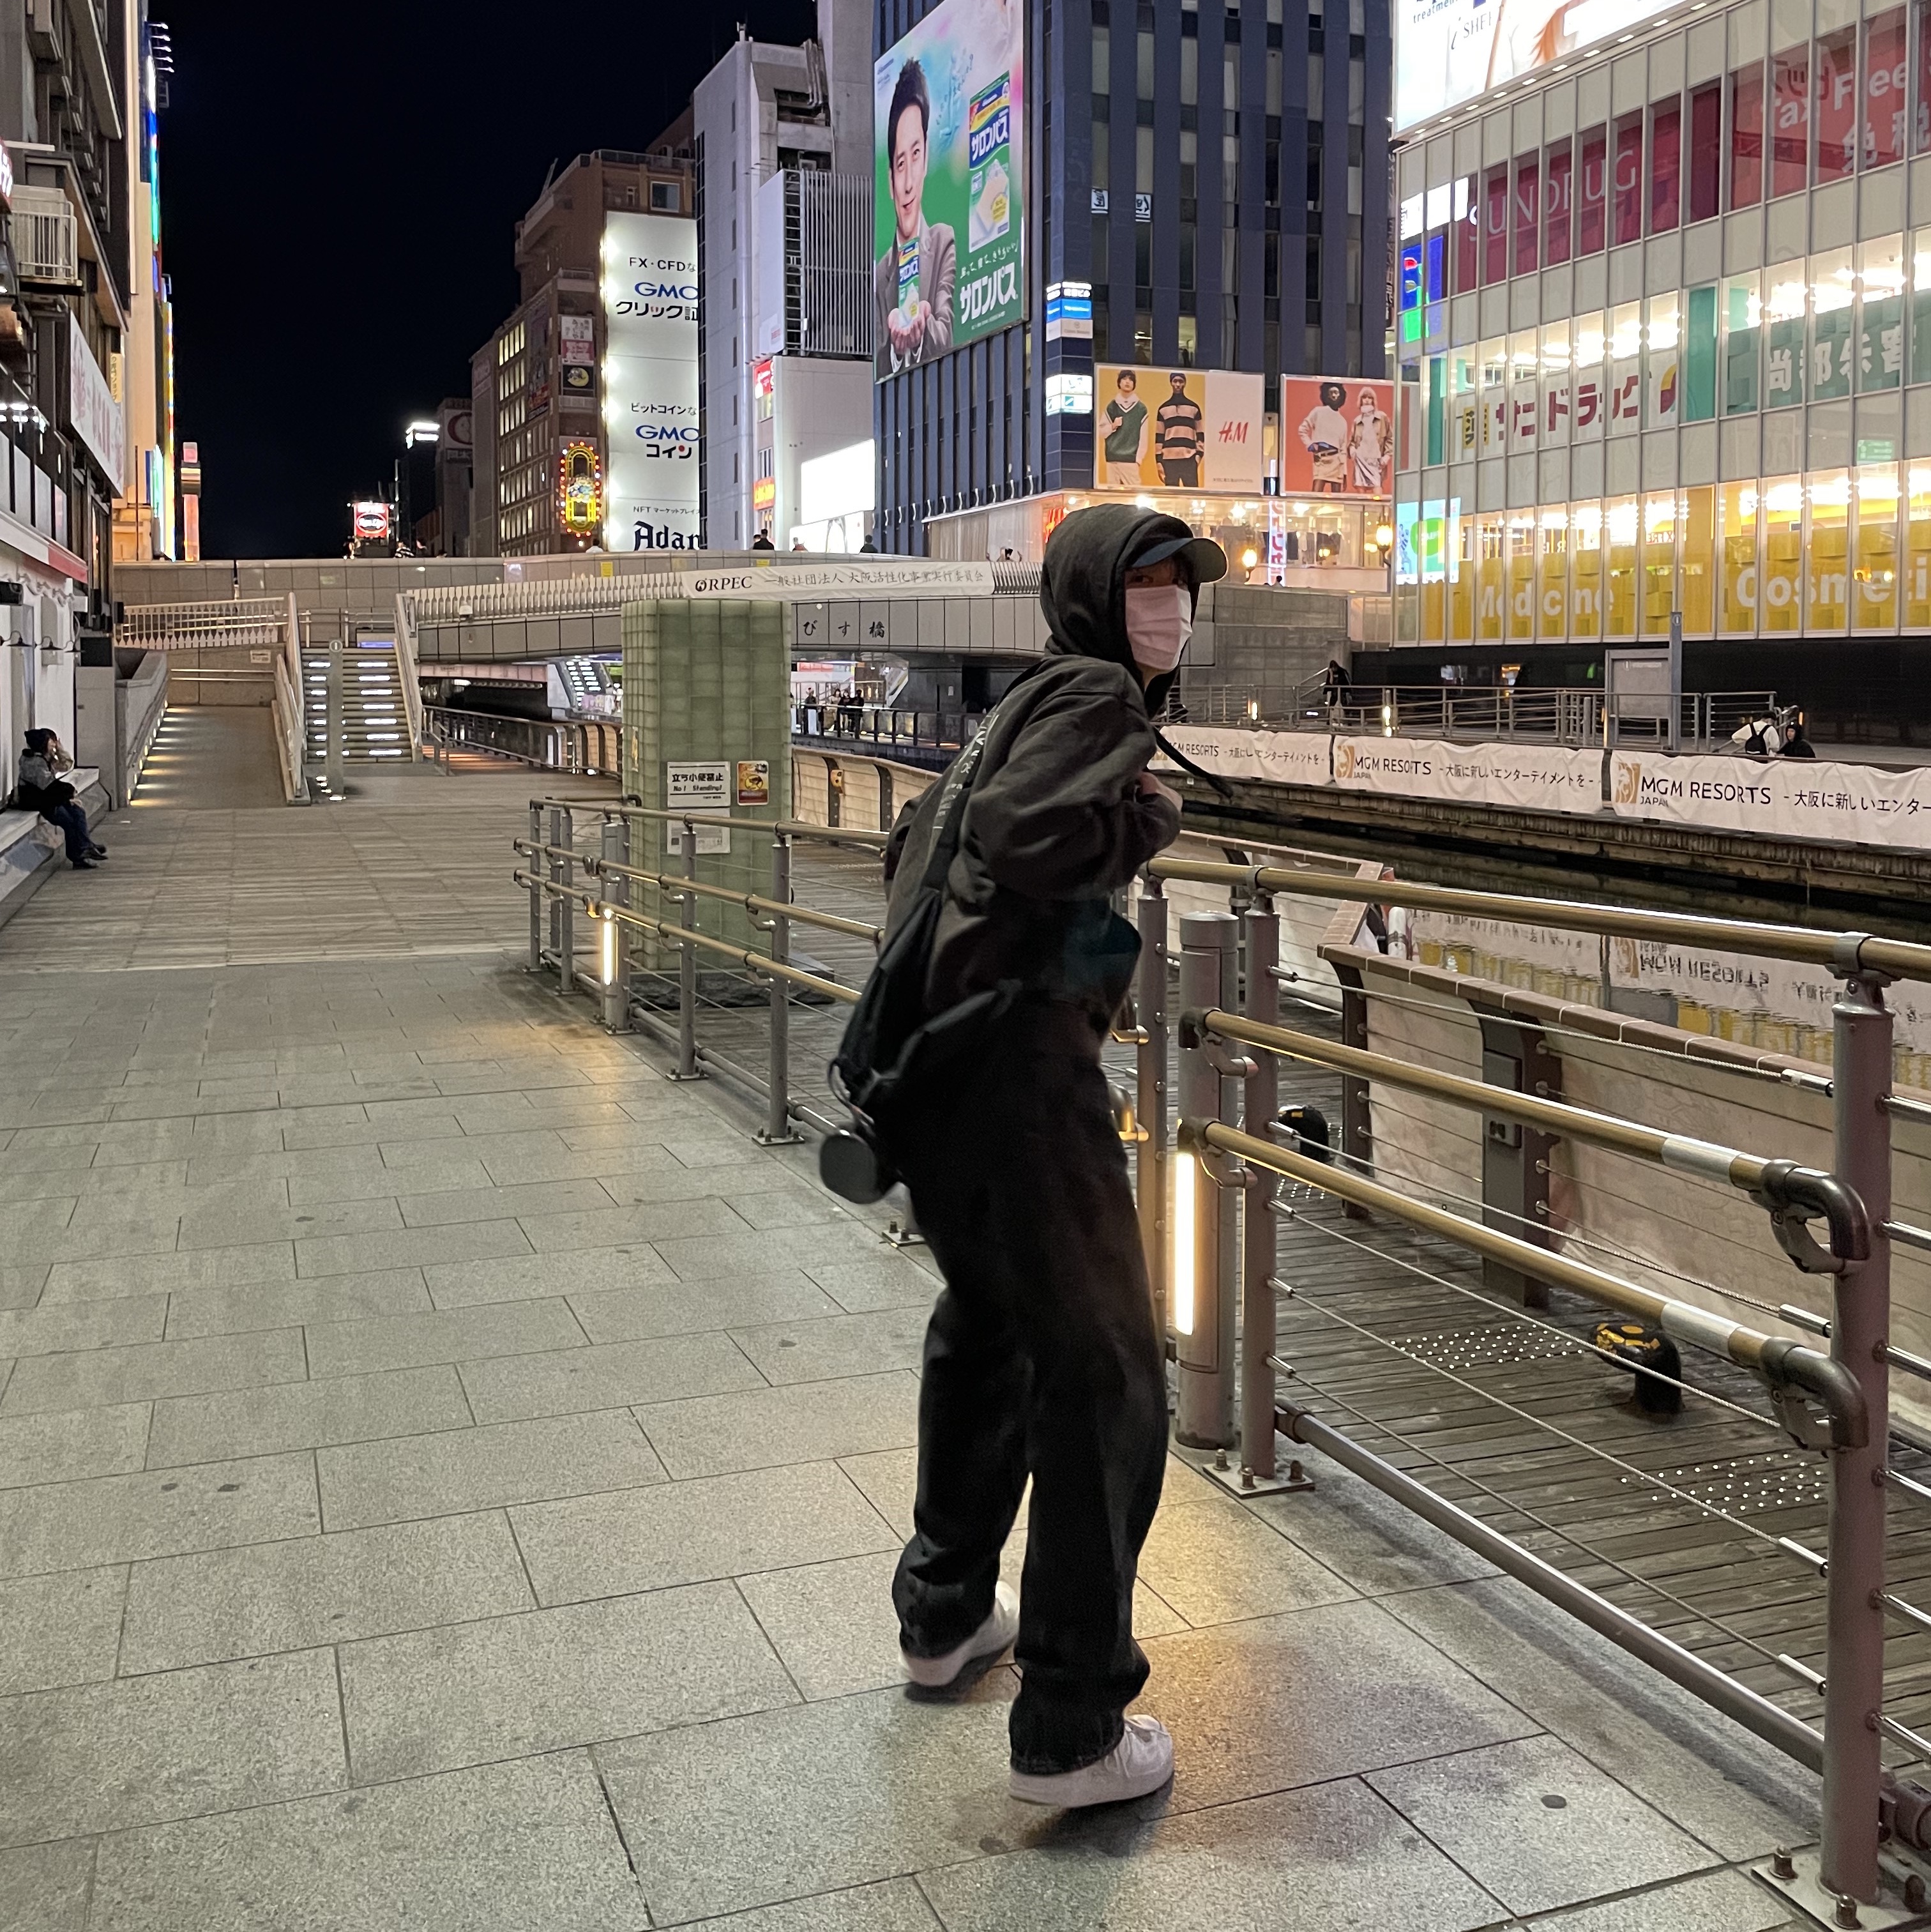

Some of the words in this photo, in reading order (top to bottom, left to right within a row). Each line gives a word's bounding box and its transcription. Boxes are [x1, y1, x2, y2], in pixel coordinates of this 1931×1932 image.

[1834, 61, 1906, 110] Fee
[971, 115, 1008, 161] サロンパス
[635, 282, 699, 300] GMO
[960, 262, 1017, 324] サロンパス
[635, 425, 700, 441] GMO
[1218, 421, 1248, 444] H&M
[646, 444, 692, 459] コイン
[764, 572, 844, 586] 一般社団法人
[1736, 556, 1927, 607] Cosmei
[1354, 756, 1380, 771] MGM
[1640, 775, 1683, 797] MGM
[1690, 781, 1771, 805] RESORTS
